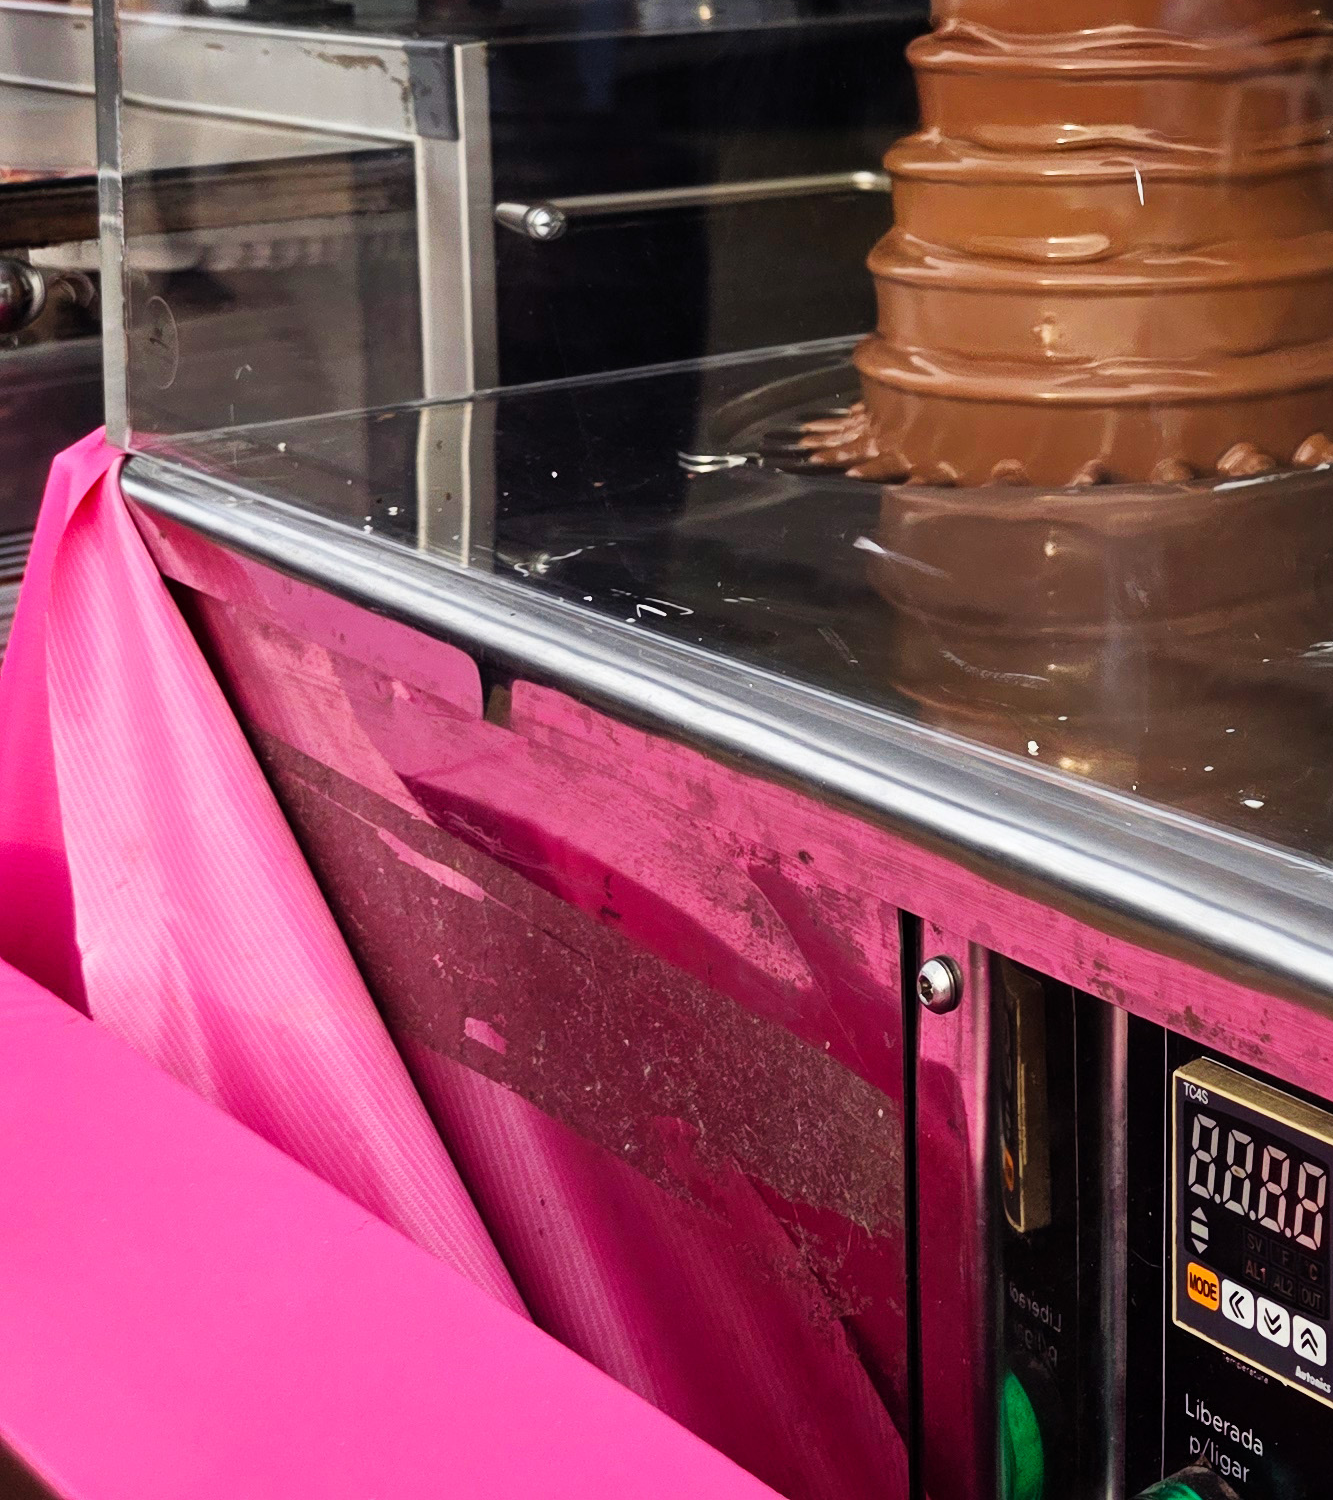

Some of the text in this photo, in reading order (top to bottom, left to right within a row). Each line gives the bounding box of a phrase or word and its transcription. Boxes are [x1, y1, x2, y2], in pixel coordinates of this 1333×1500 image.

[1183, 1082, 1209, 1105] TC4S
[1189, 1271, 1218, 1302] MODE
[1295, 1365, 1332, 1394] Autonics
[1185, 1393, 1264, 1457] Liberada
[1189, 1435, 1250, 1483] p/ligar
